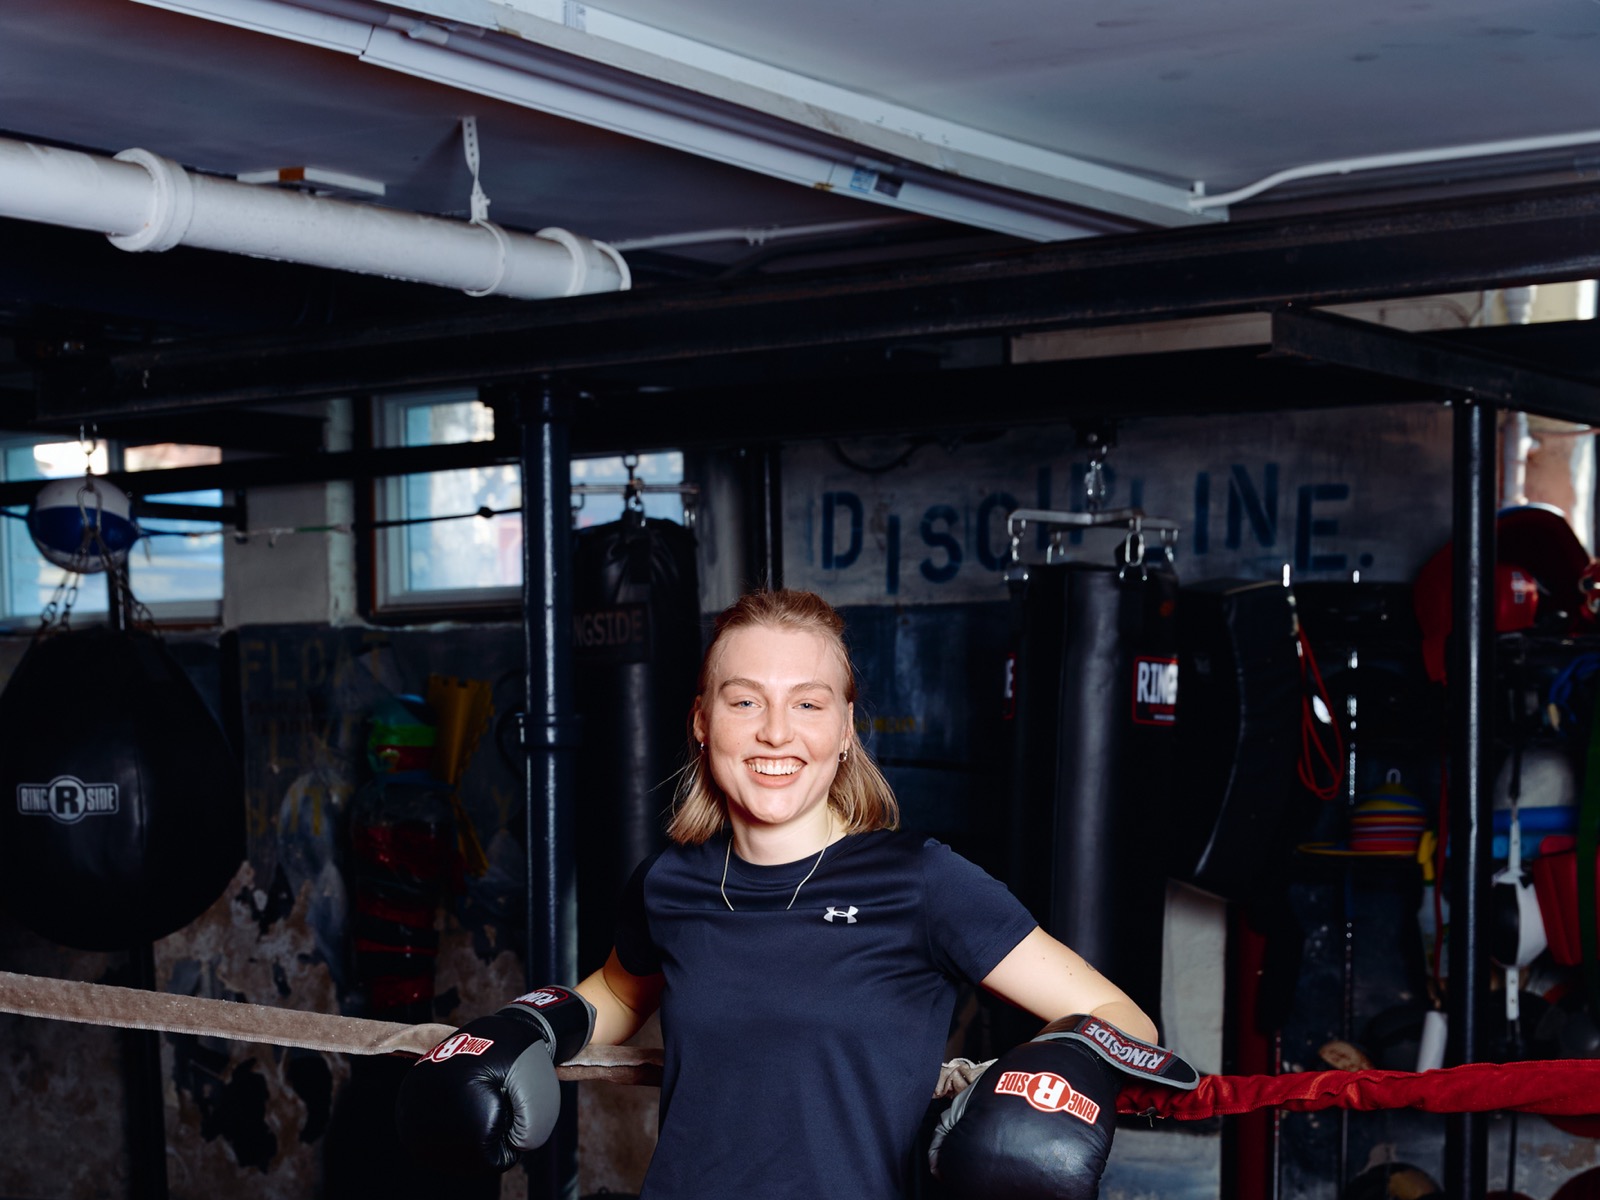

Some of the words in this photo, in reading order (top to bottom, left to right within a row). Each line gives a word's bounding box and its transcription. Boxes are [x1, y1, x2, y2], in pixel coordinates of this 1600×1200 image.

[573, 609, 643, 647] NGSIDE
[20, 787, 48, 811] RING
[56, 786, 79, 814] R
[86, 787, 115, 811] SIDE
[460, 1037, 491, 1054] RING
[1084, 1023, 1167, 1070] RINGSIDE
[997, 1073, 1030, 1093] SIDE
[1033, 1075, 1066, 1109] R
[1067, 1093, 1098, 1122] RING
